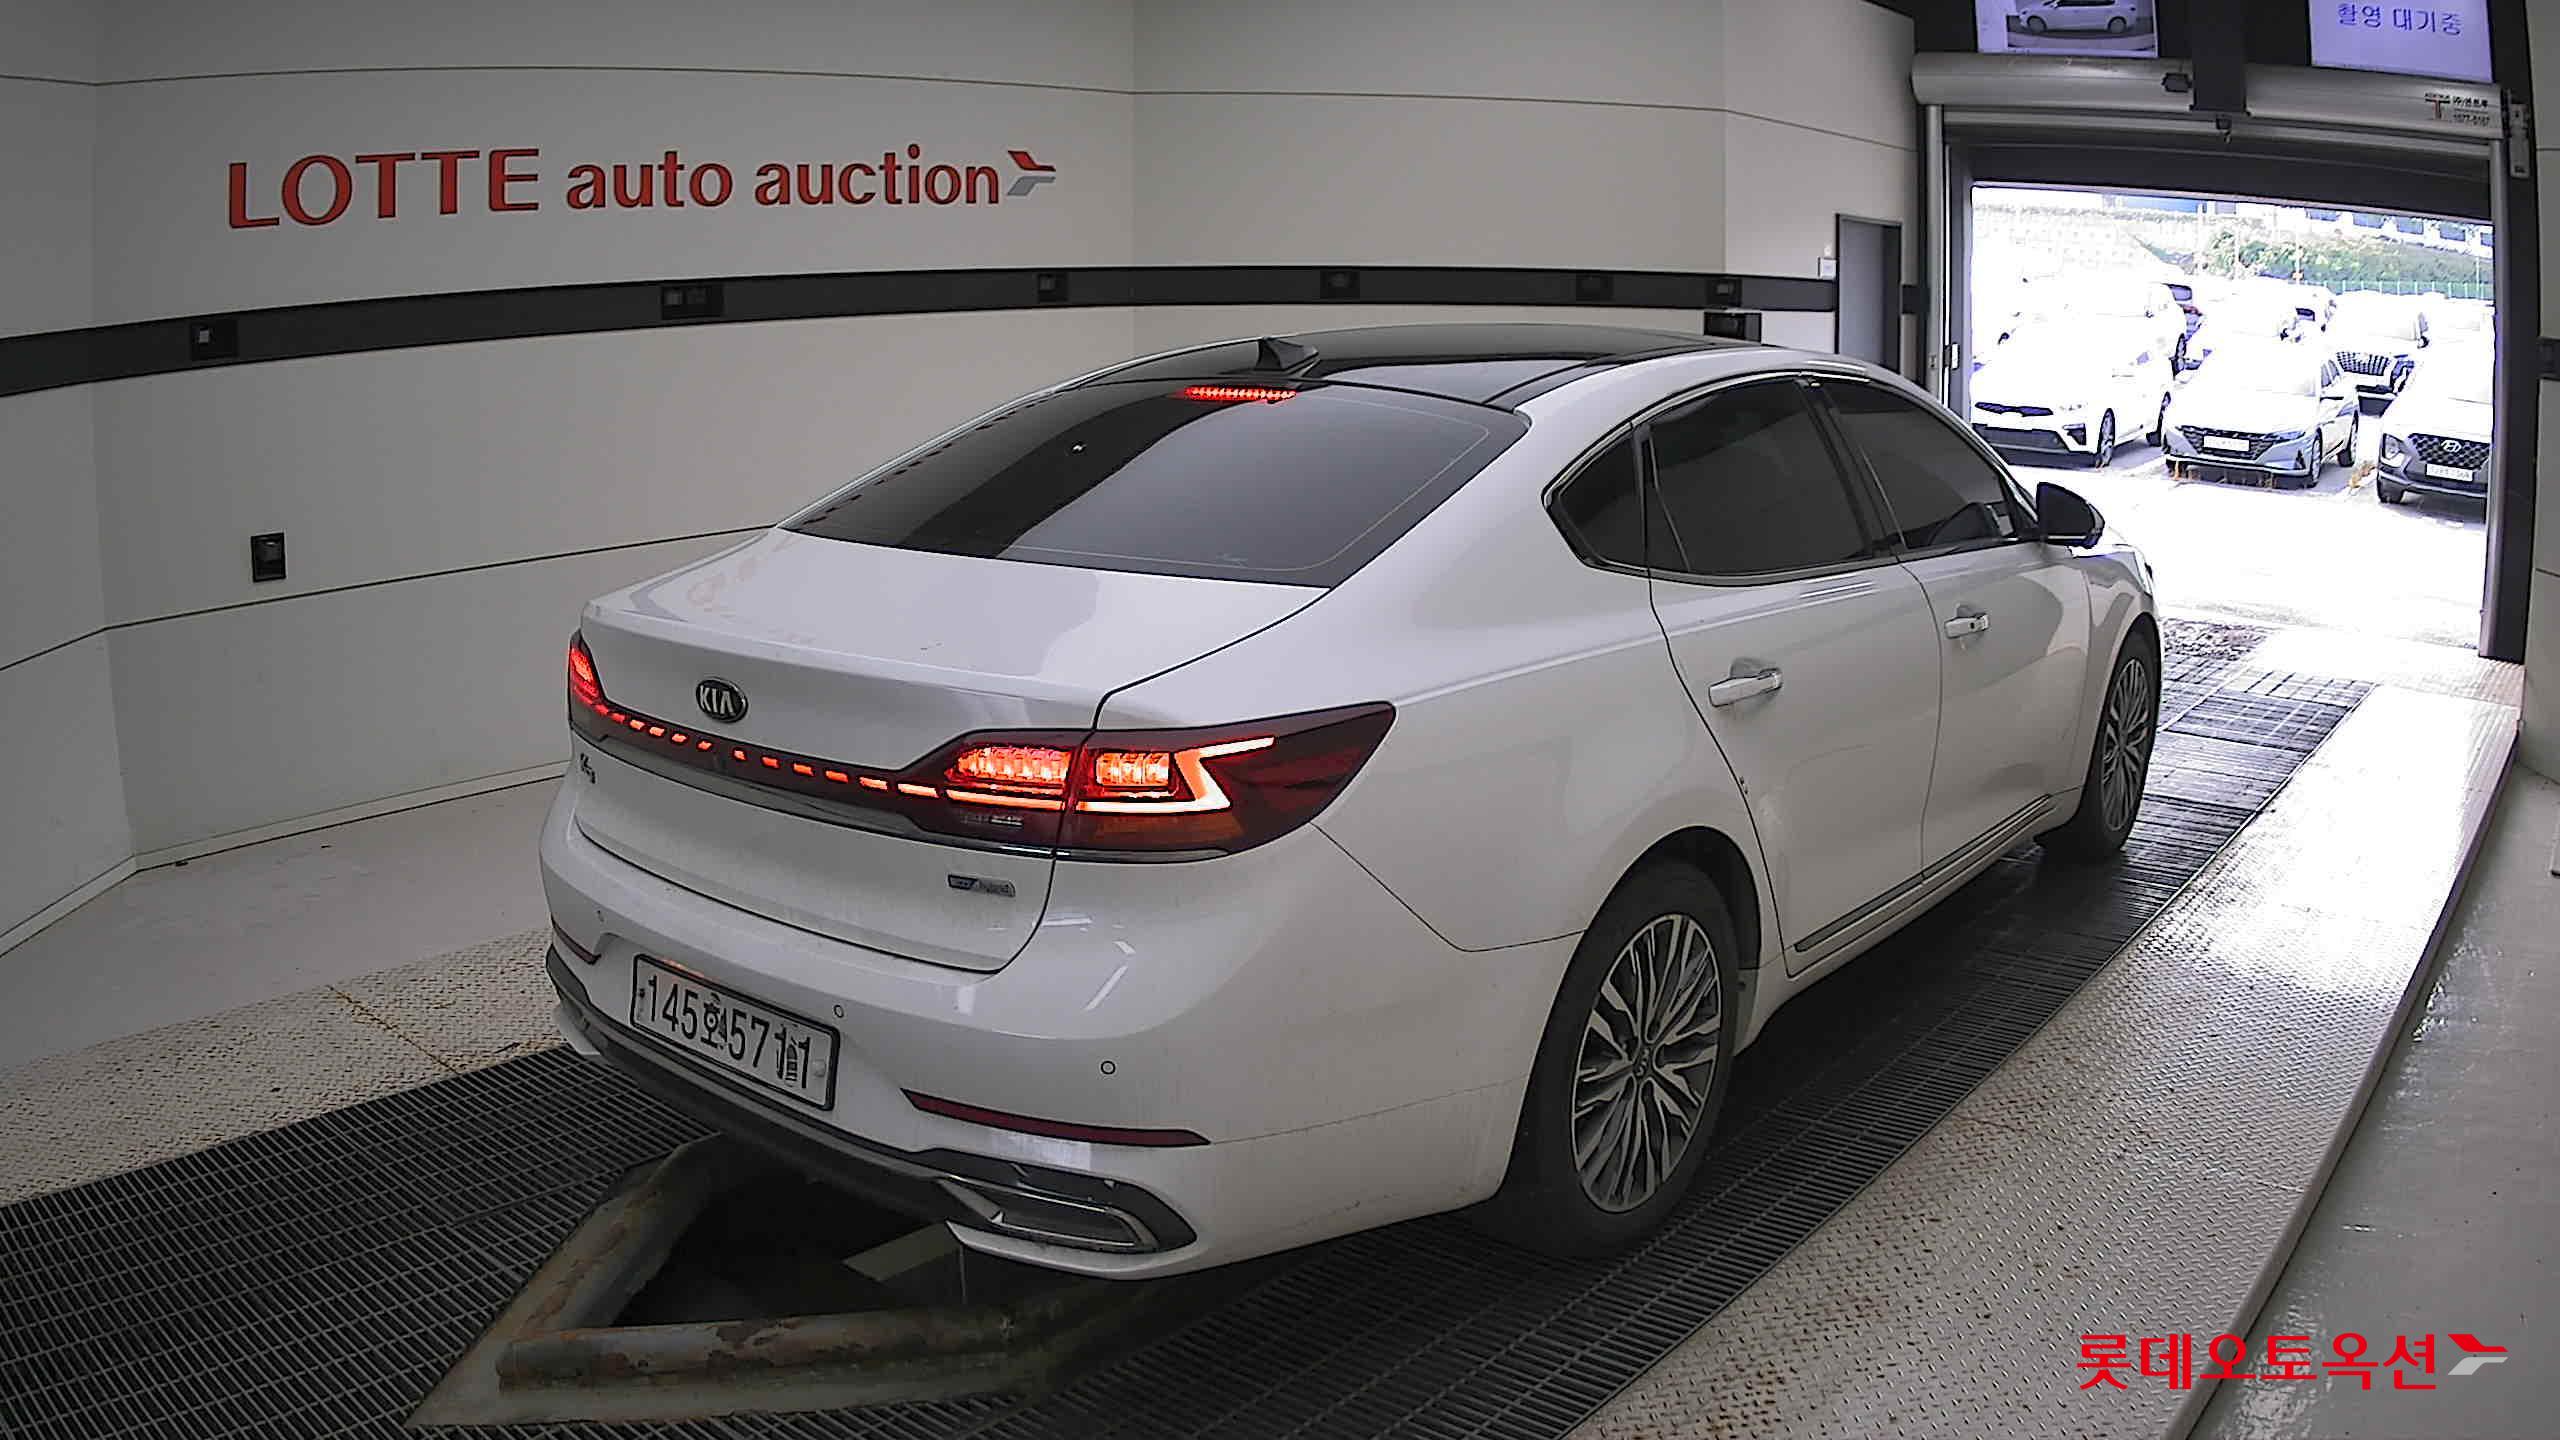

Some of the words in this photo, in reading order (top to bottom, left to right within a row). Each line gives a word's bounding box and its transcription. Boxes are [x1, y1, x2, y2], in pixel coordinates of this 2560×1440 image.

[2338, 3, 2382, 28] 촬영
[2393, 9, 2462, 36] 대기중
[229, 149, 539, 228] LOTTE
[566, 151, 733, 208] auto
[754, 143, 1000, 205] auction
[699, 684, 737, 717] KIA
